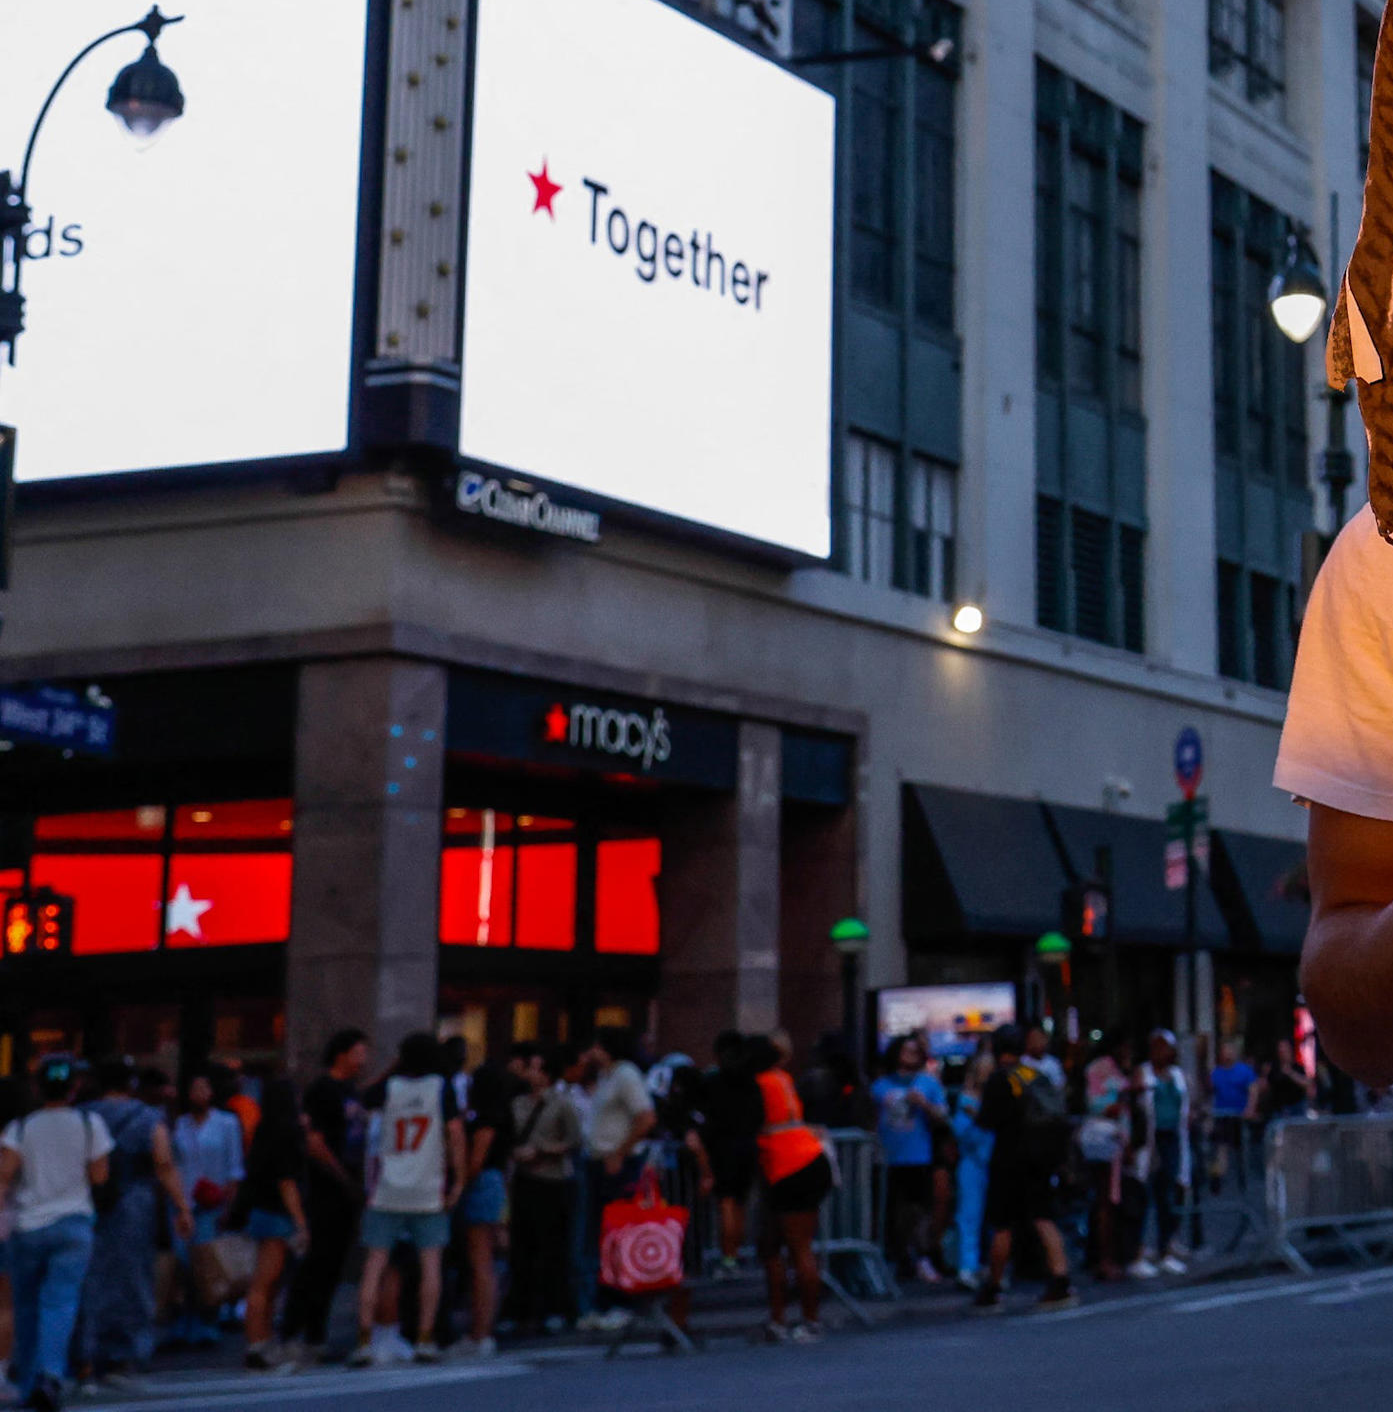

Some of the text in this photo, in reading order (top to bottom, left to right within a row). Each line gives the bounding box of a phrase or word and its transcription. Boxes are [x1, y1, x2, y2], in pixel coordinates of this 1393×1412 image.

[582, 175, 768, 312] Together
[569, 703, 671, 770] macy's
[394, 1114, 431, 1154] 17
